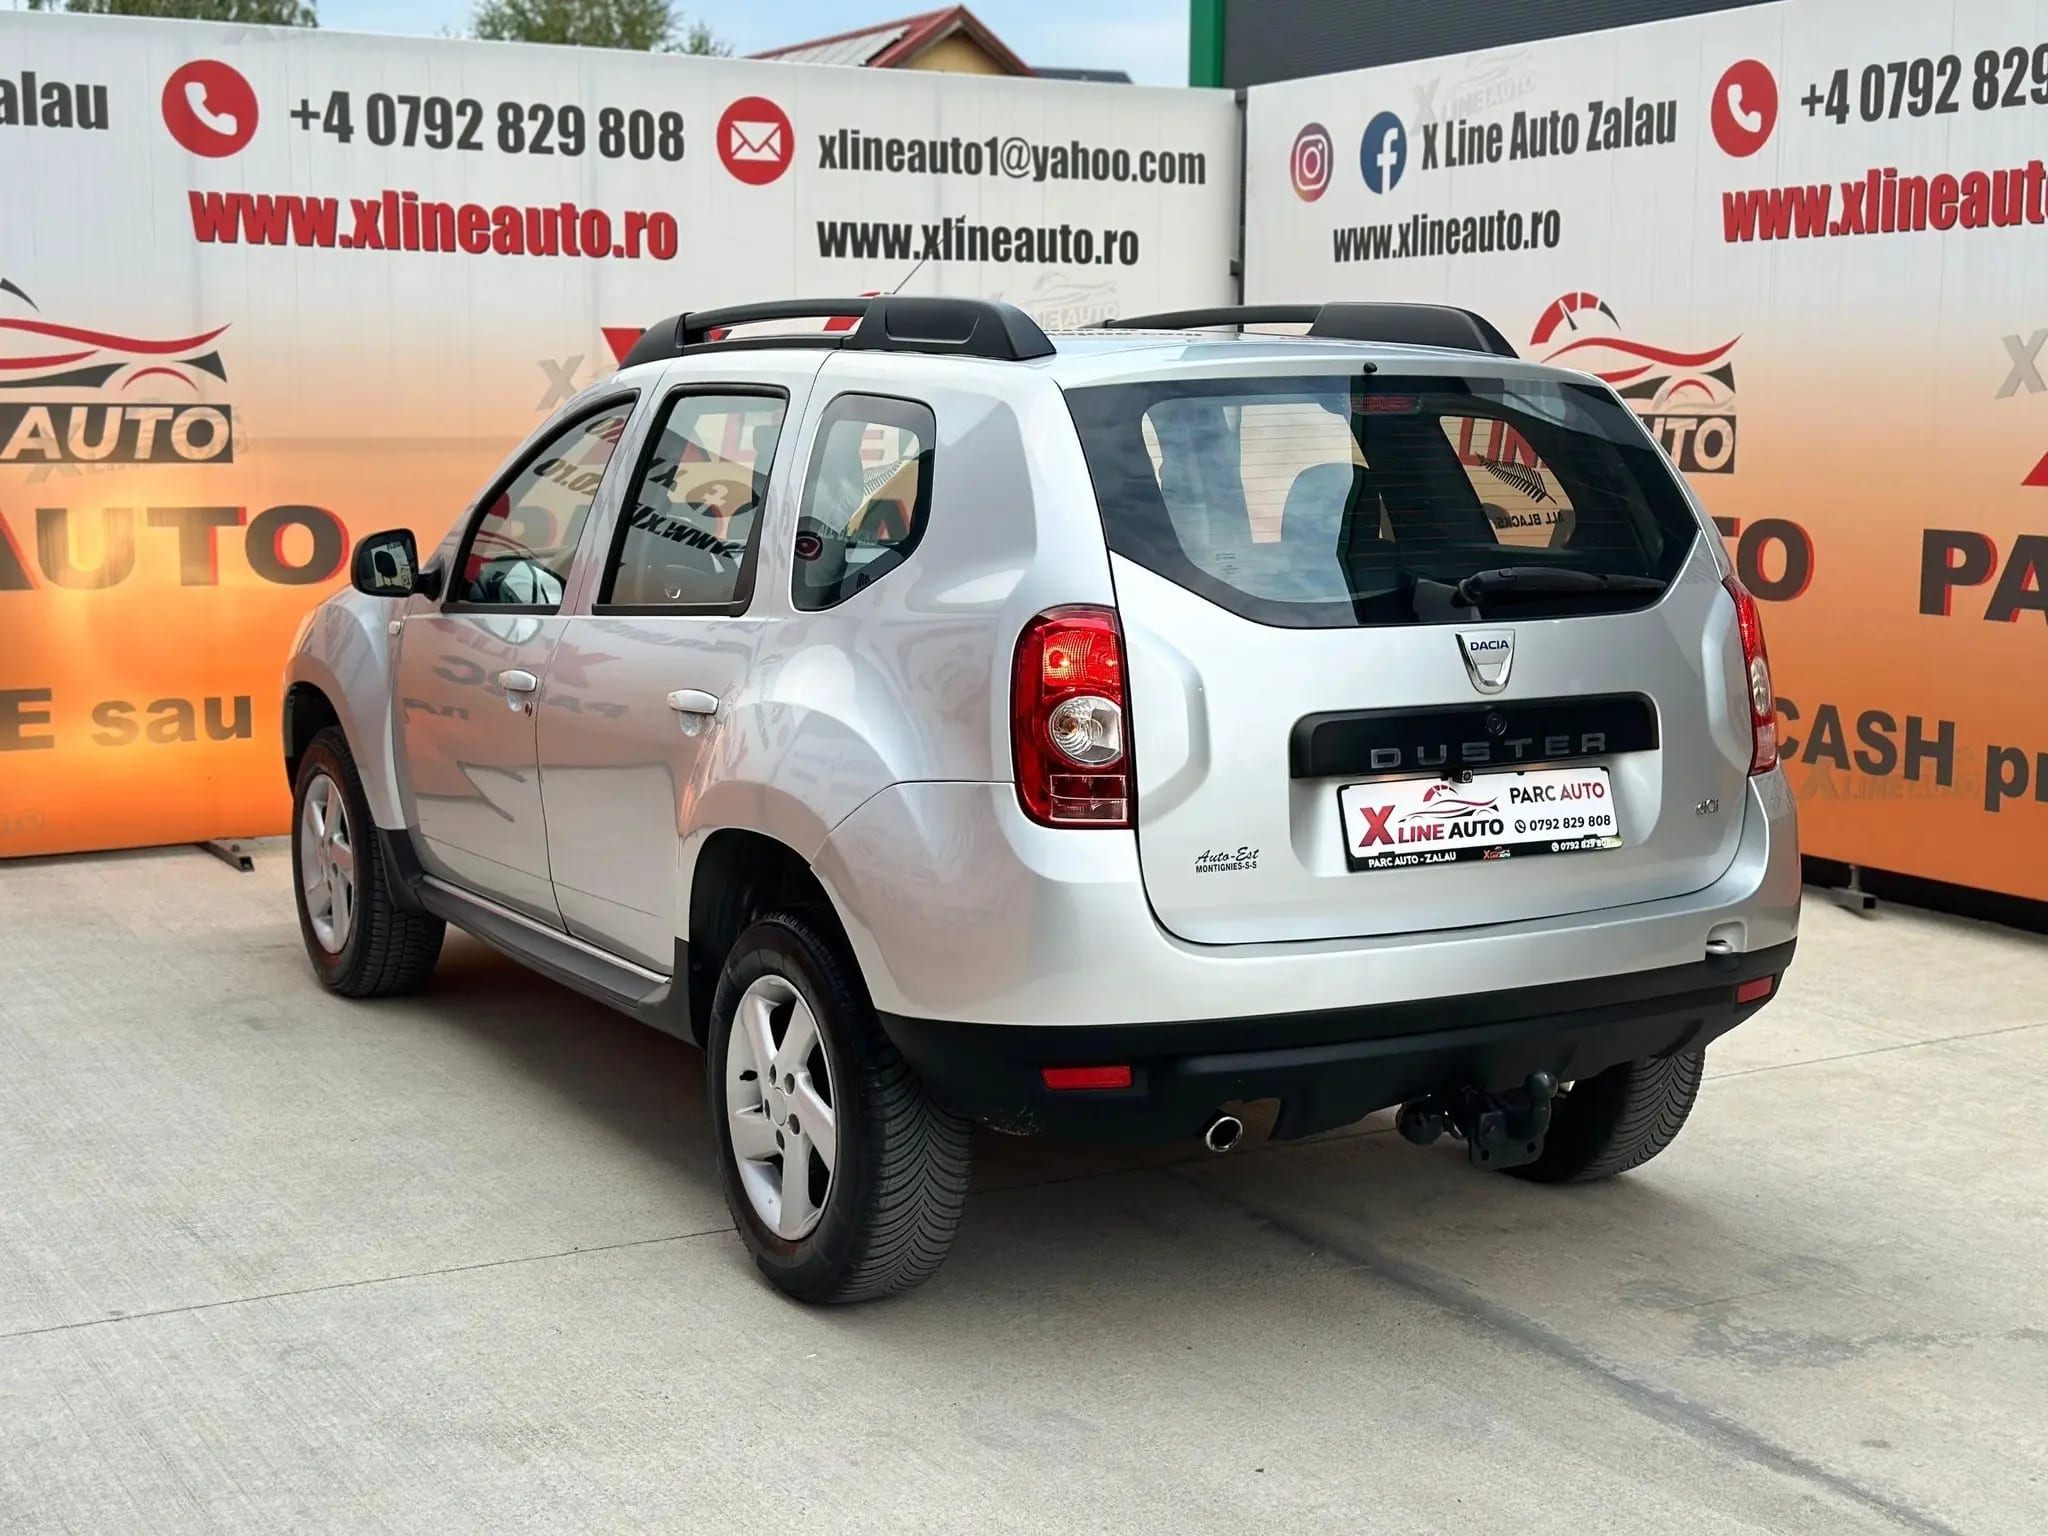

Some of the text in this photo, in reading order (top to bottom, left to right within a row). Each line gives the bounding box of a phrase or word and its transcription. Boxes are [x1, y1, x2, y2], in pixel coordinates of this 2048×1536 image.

[1800, 43, 2048, 125] +4 0792 829
[290, 91, 685, 162] +4 0792 829 808
[1422, 96, 1677, 170] X Line Auto Zalau
[818, 129, 1206, 185] xlineauto1@yahoo.com
[190, 190, 678, 260] www.xlineauto.ro
[1722, 160, 2048, 242] www.xlineaut
[817, 215, 1139, 266] www.xlineauto.ro
[1333, 210, 1561, 263] www.xlineauto.ro
[1, 406, 230, 461] AUTO
[1470, 640, 1510, 651] DACIA
[91, 694, 253, 746] sau
[1370, 732, 1607, 769] DUSTER
[1509, 782, 1605, 804] PARC AUTO
[1358, 804, 1505, 848] X LINE AUTO
[1529, 814, 1612, 832] 0792 829 808
[1560, 841, 1580, 851] 0792
[1194, 846, 1260, 864] Auto-Est
[1195, 860, 1257, 873] MONTIGNIES-S-S
[1367, 857, 1393, 869] PARC
[1394, 855, 1419, 867] AUTO
[1424, 851, 1457, 864] ZALAU
